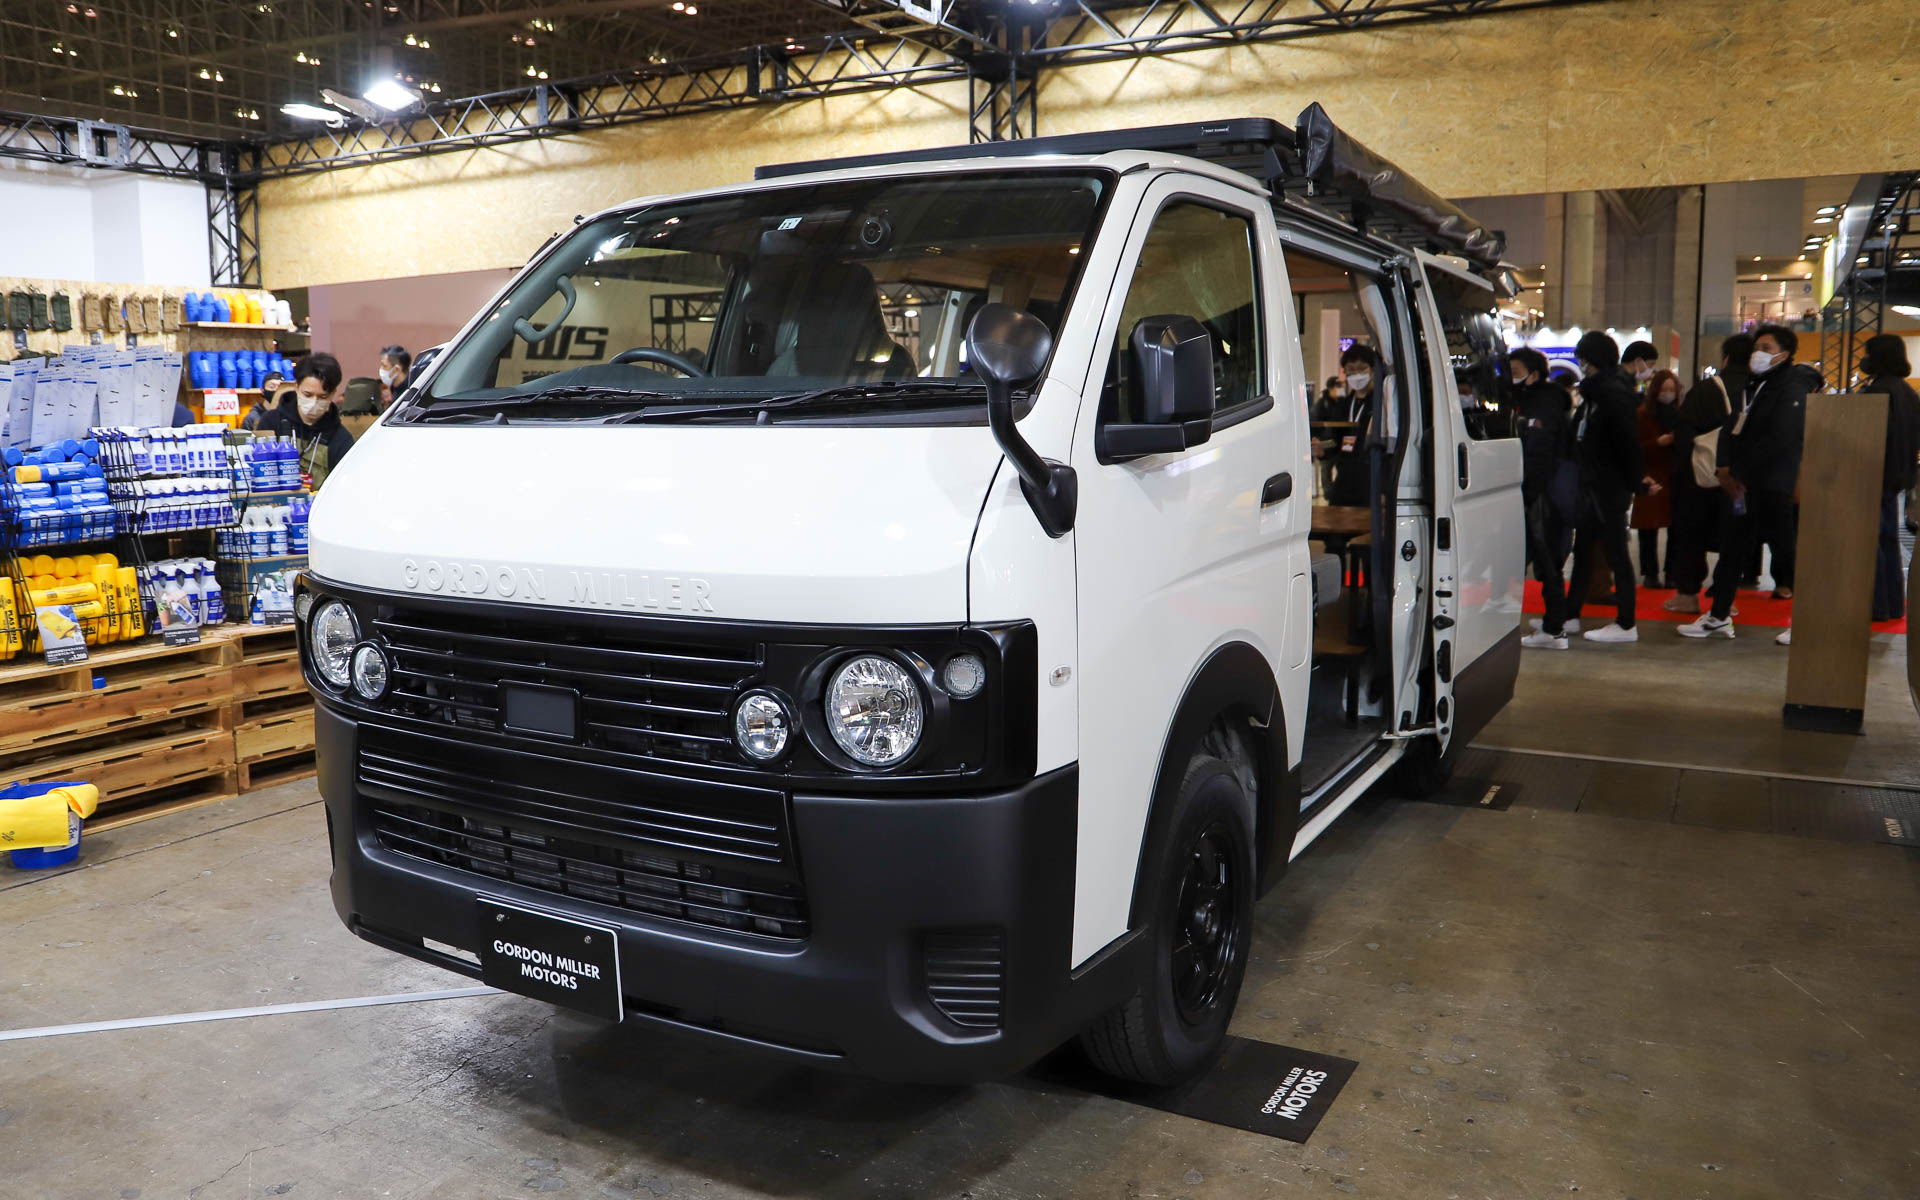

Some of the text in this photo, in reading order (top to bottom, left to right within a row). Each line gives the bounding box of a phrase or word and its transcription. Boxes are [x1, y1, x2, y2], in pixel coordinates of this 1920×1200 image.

[498, 322, 609, 360] WS
[401, 558, 714, 612] GORDON MILLER
[493, 939, 601, 980] GORDON MILLER
[521, 963, 578, 990] MOTORS
[1261, 1067, 1305, 1114] GORDON MILLER
[1276, 1069, 1328, 1120] MOTORS
